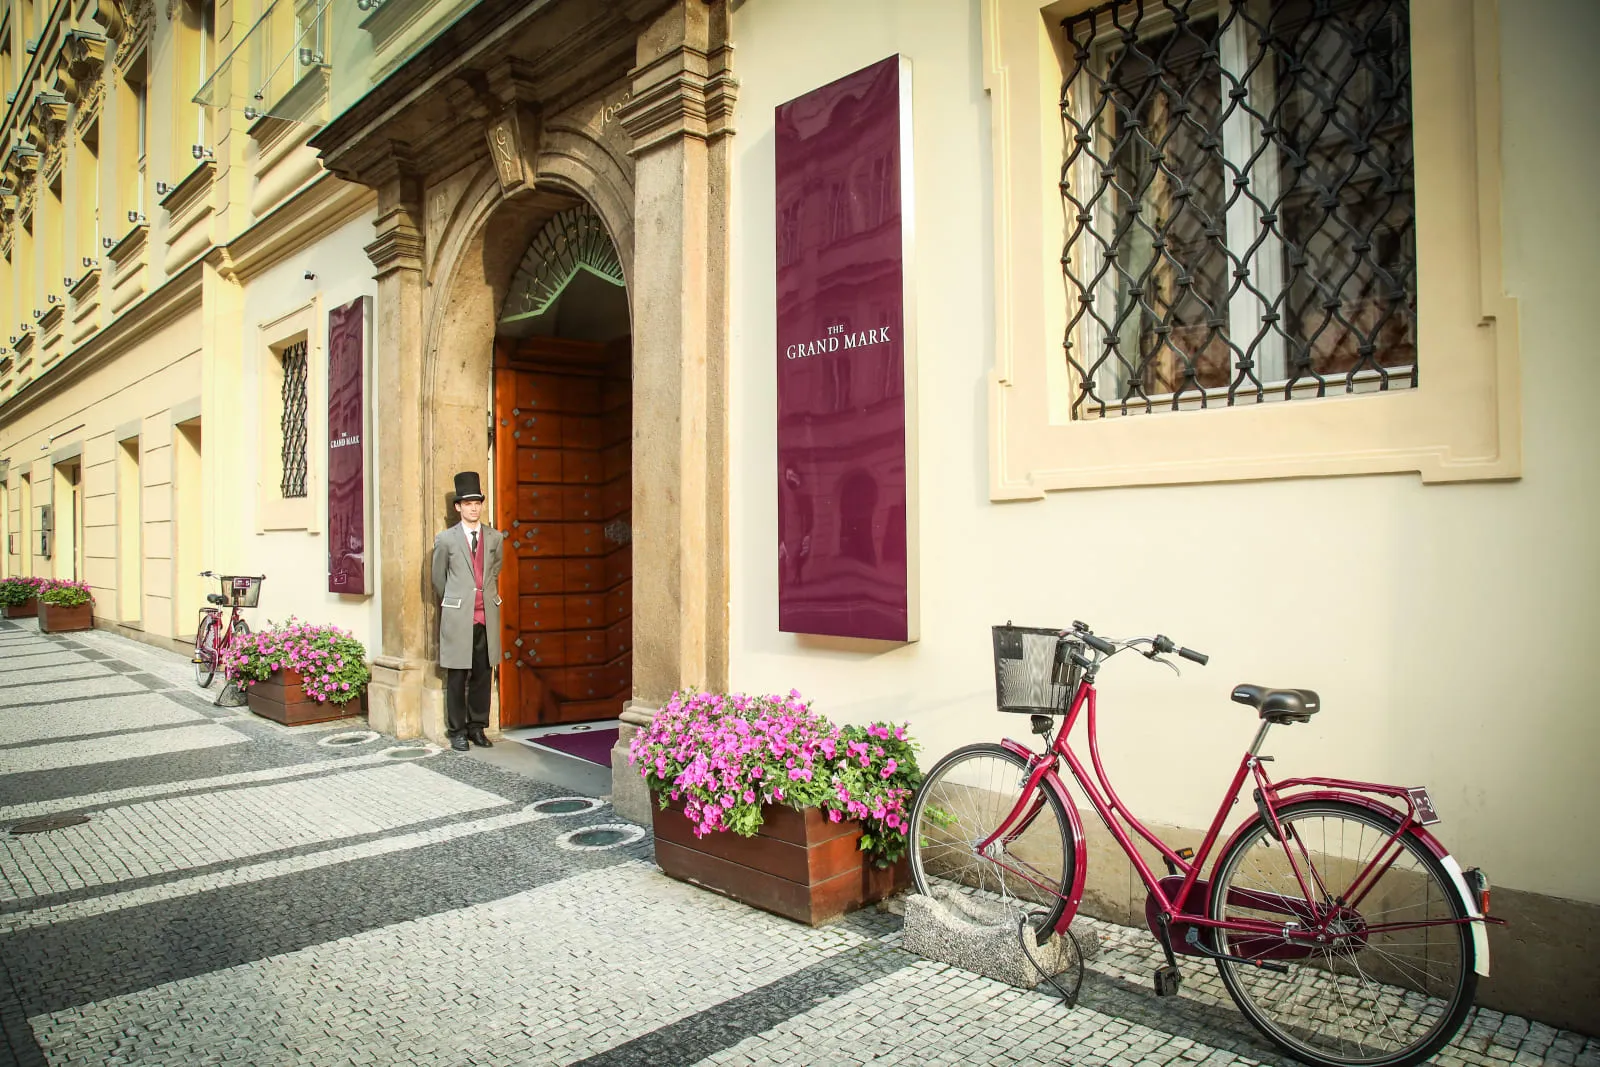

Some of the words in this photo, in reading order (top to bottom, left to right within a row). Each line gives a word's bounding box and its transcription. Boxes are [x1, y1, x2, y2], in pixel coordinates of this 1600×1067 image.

[827, 324, 845, 335] THE
[786, 336, 839, 360] GRAND
[844, 326, 891, 350] MARK
